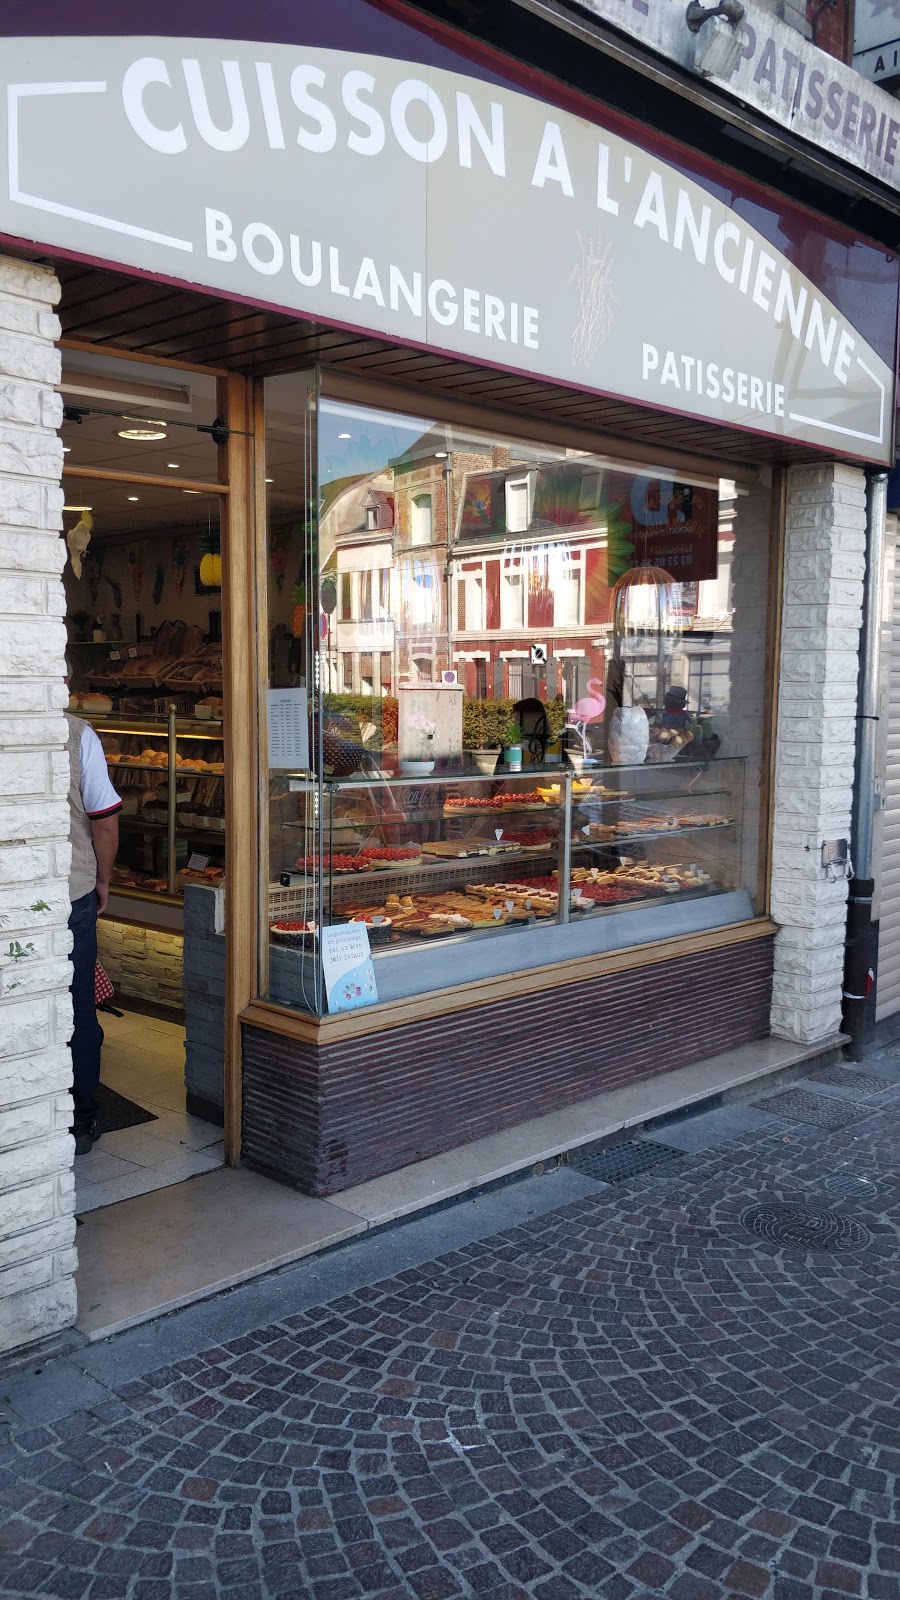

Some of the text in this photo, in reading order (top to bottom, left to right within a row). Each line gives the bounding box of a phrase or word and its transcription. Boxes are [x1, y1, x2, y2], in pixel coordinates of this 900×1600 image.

[121, 57, 856, 385] CUISSON A L'ANCIENNE
[204, 207, 539, 350] BOULANGERIE
[642, 343, 785, 418] PATISSERIE
